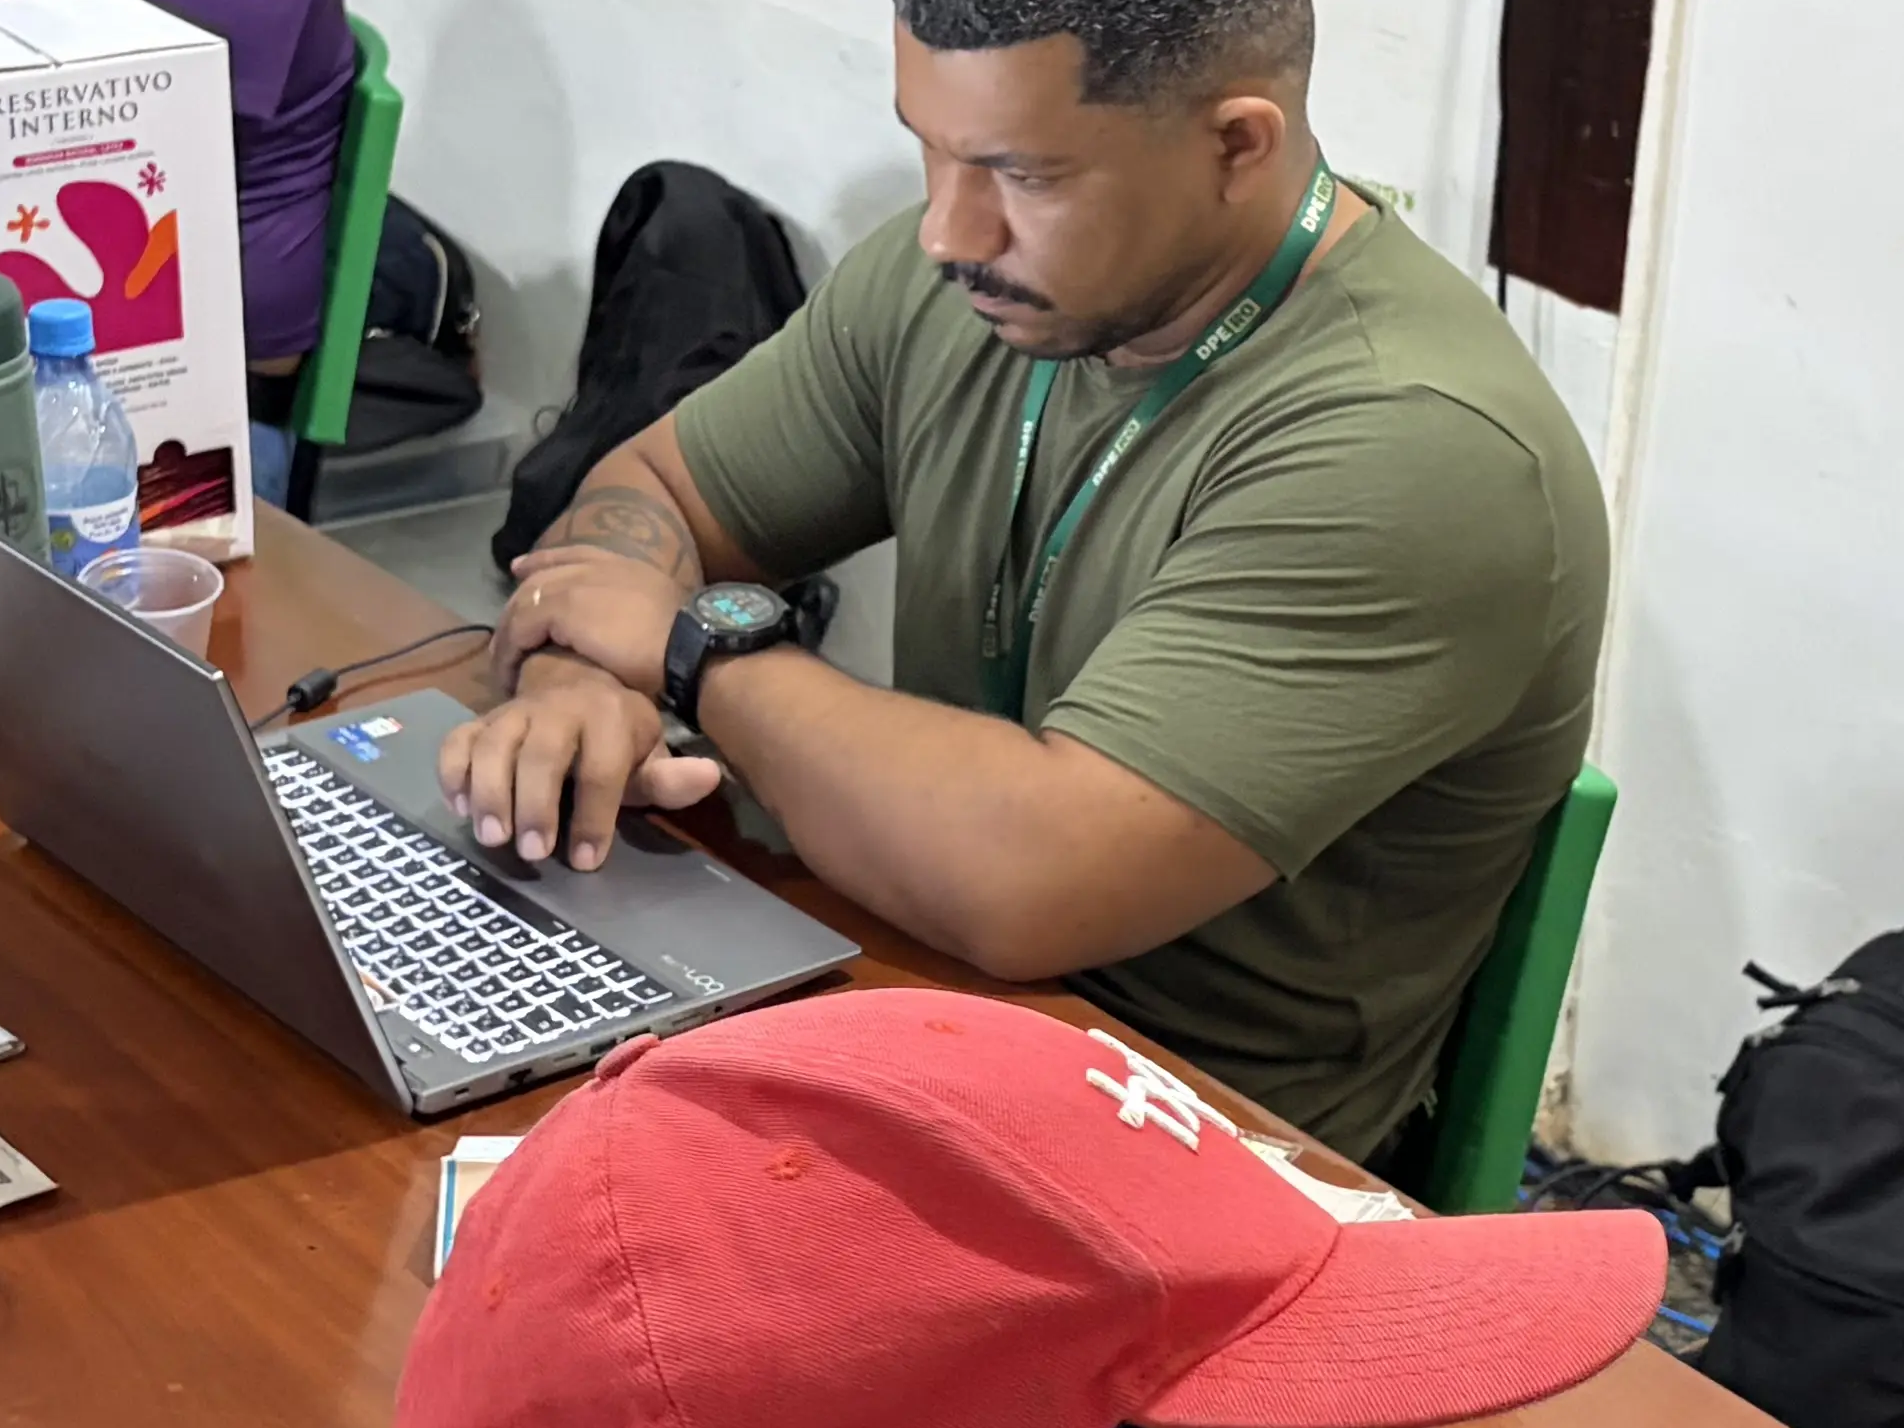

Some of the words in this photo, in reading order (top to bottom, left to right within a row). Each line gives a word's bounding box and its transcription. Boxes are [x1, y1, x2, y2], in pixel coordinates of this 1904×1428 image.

[9, 102, 139, 139] INTERNO
[1300, 196, 1327, 233] DPE
[1196, 326, 1235, 360] DPE
